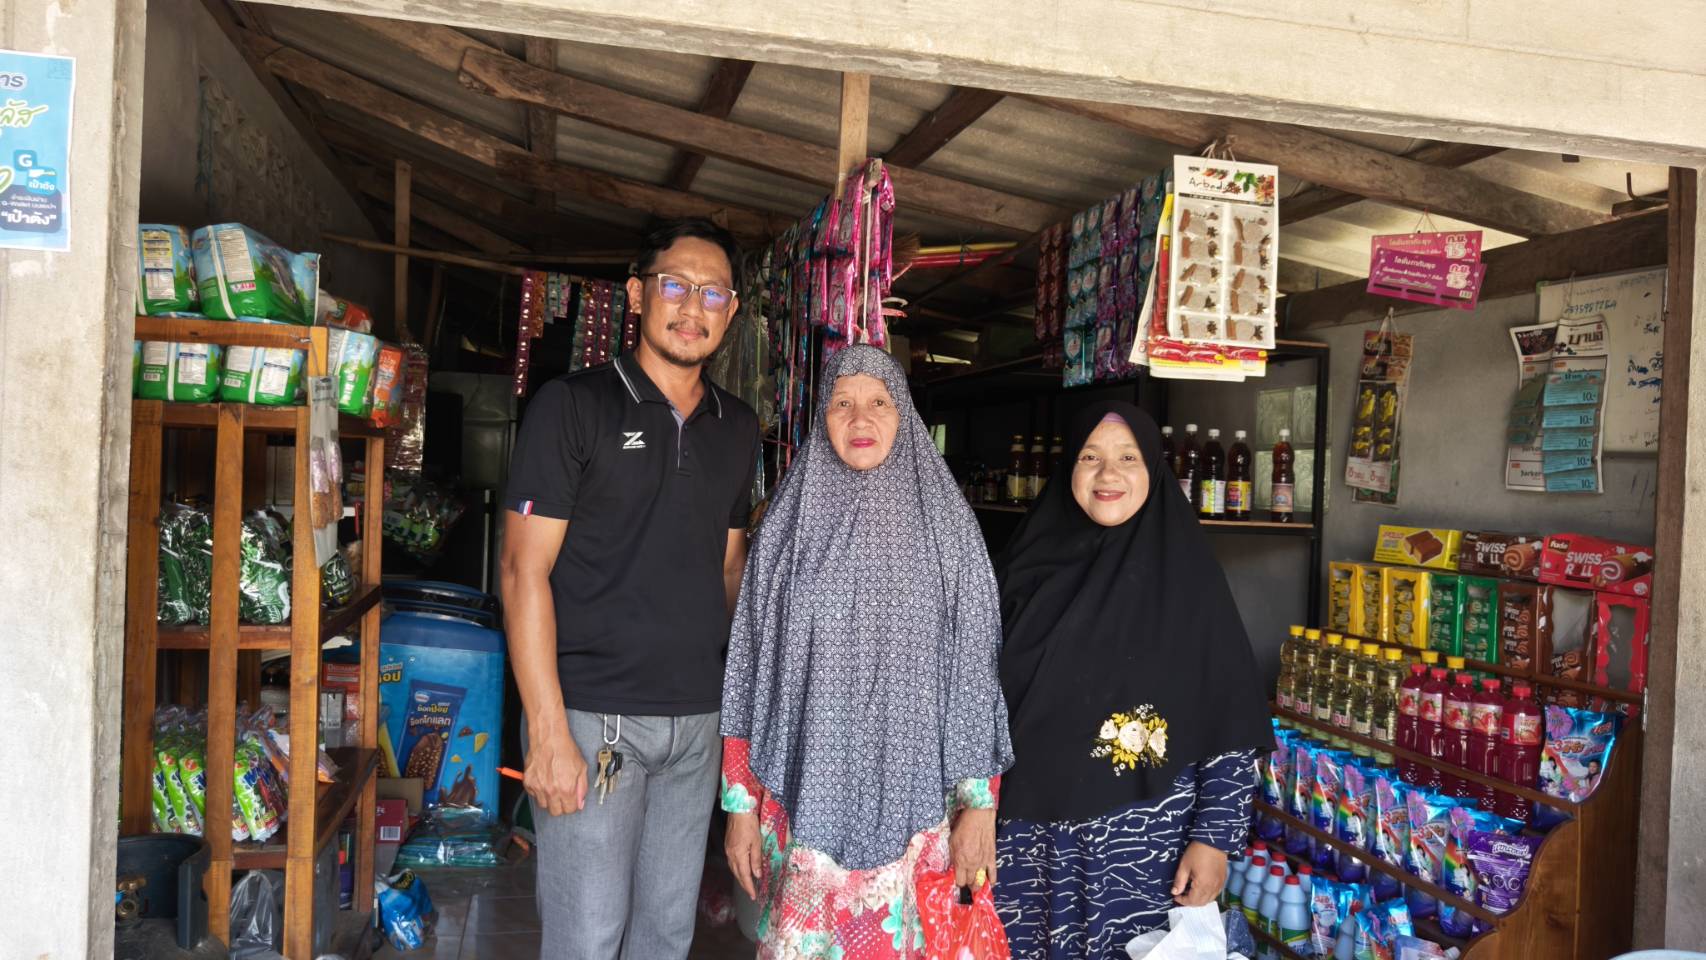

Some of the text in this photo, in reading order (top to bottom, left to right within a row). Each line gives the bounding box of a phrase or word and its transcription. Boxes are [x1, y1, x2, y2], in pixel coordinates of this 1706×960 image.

[18, 154, 33, 168] G
[1475, 541, 1507, 554] SWISS
[1477, 552, 1500, 565] RLL
[1565, 551, 1603, 565] SWISS
[1565, 563, 1594, 577] RLL
